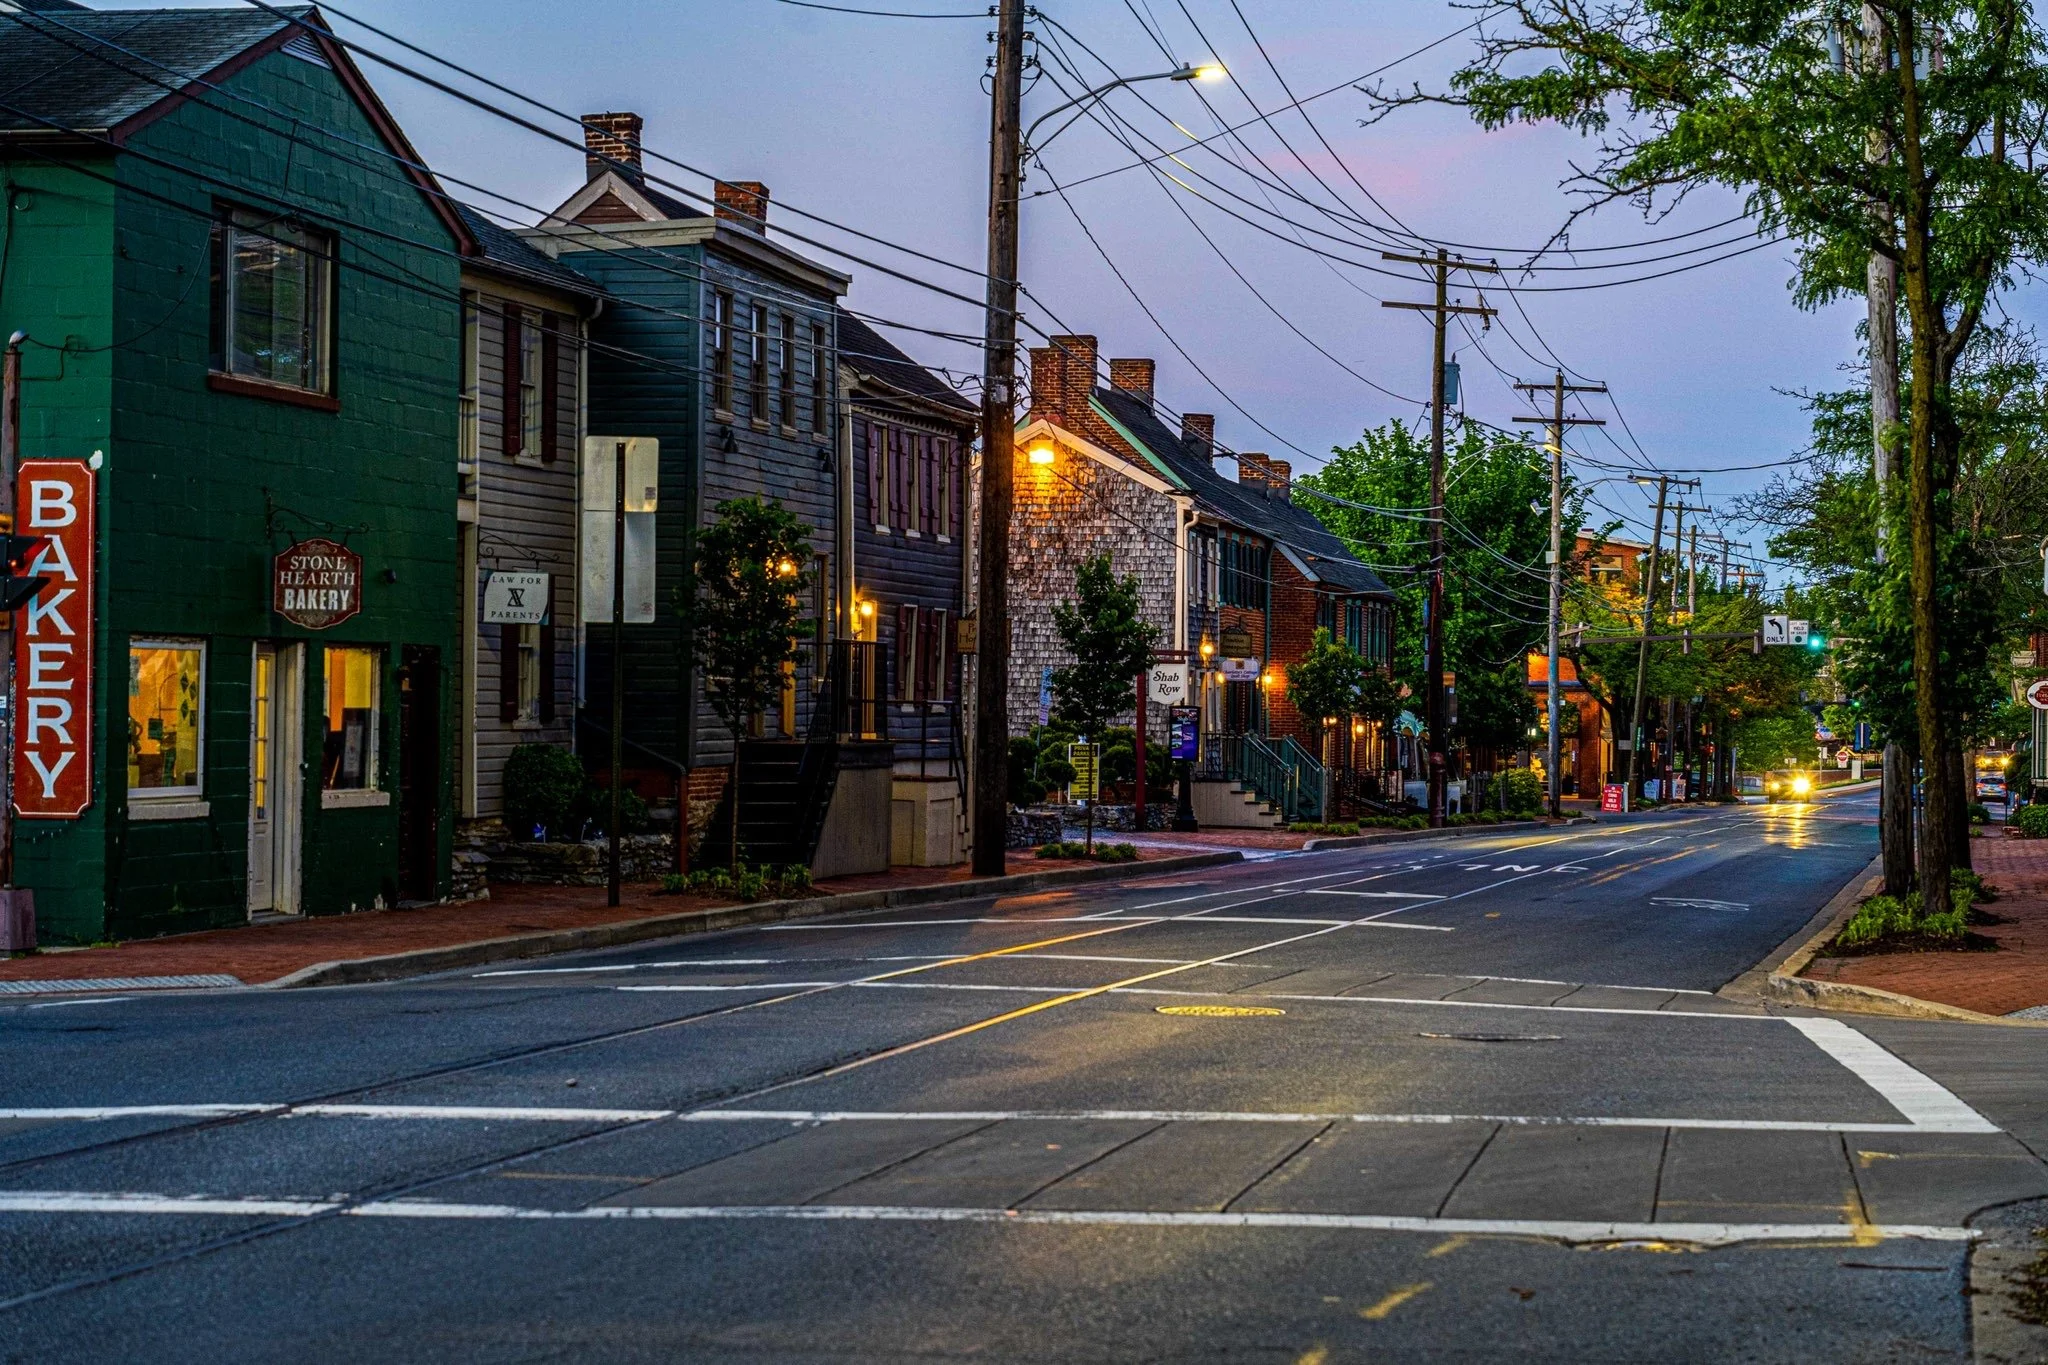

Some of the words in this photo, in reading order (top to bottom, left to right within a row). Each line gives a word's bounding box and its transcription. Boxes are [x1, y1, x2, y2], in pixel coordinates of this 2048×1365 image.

[290, 555, 347, 570] STONE
[280, 571, 356, 585] HEARTH
[492, 576, 515, 584] LAW
[284, 588, 350, 611] BAKERY
[490, 611, 541, 619] PARENTS
[25, 479, 78, 798] BAKERY
[1153, 671, 1179, 681] Shab
[1158, 683, 1180, 695] Row
